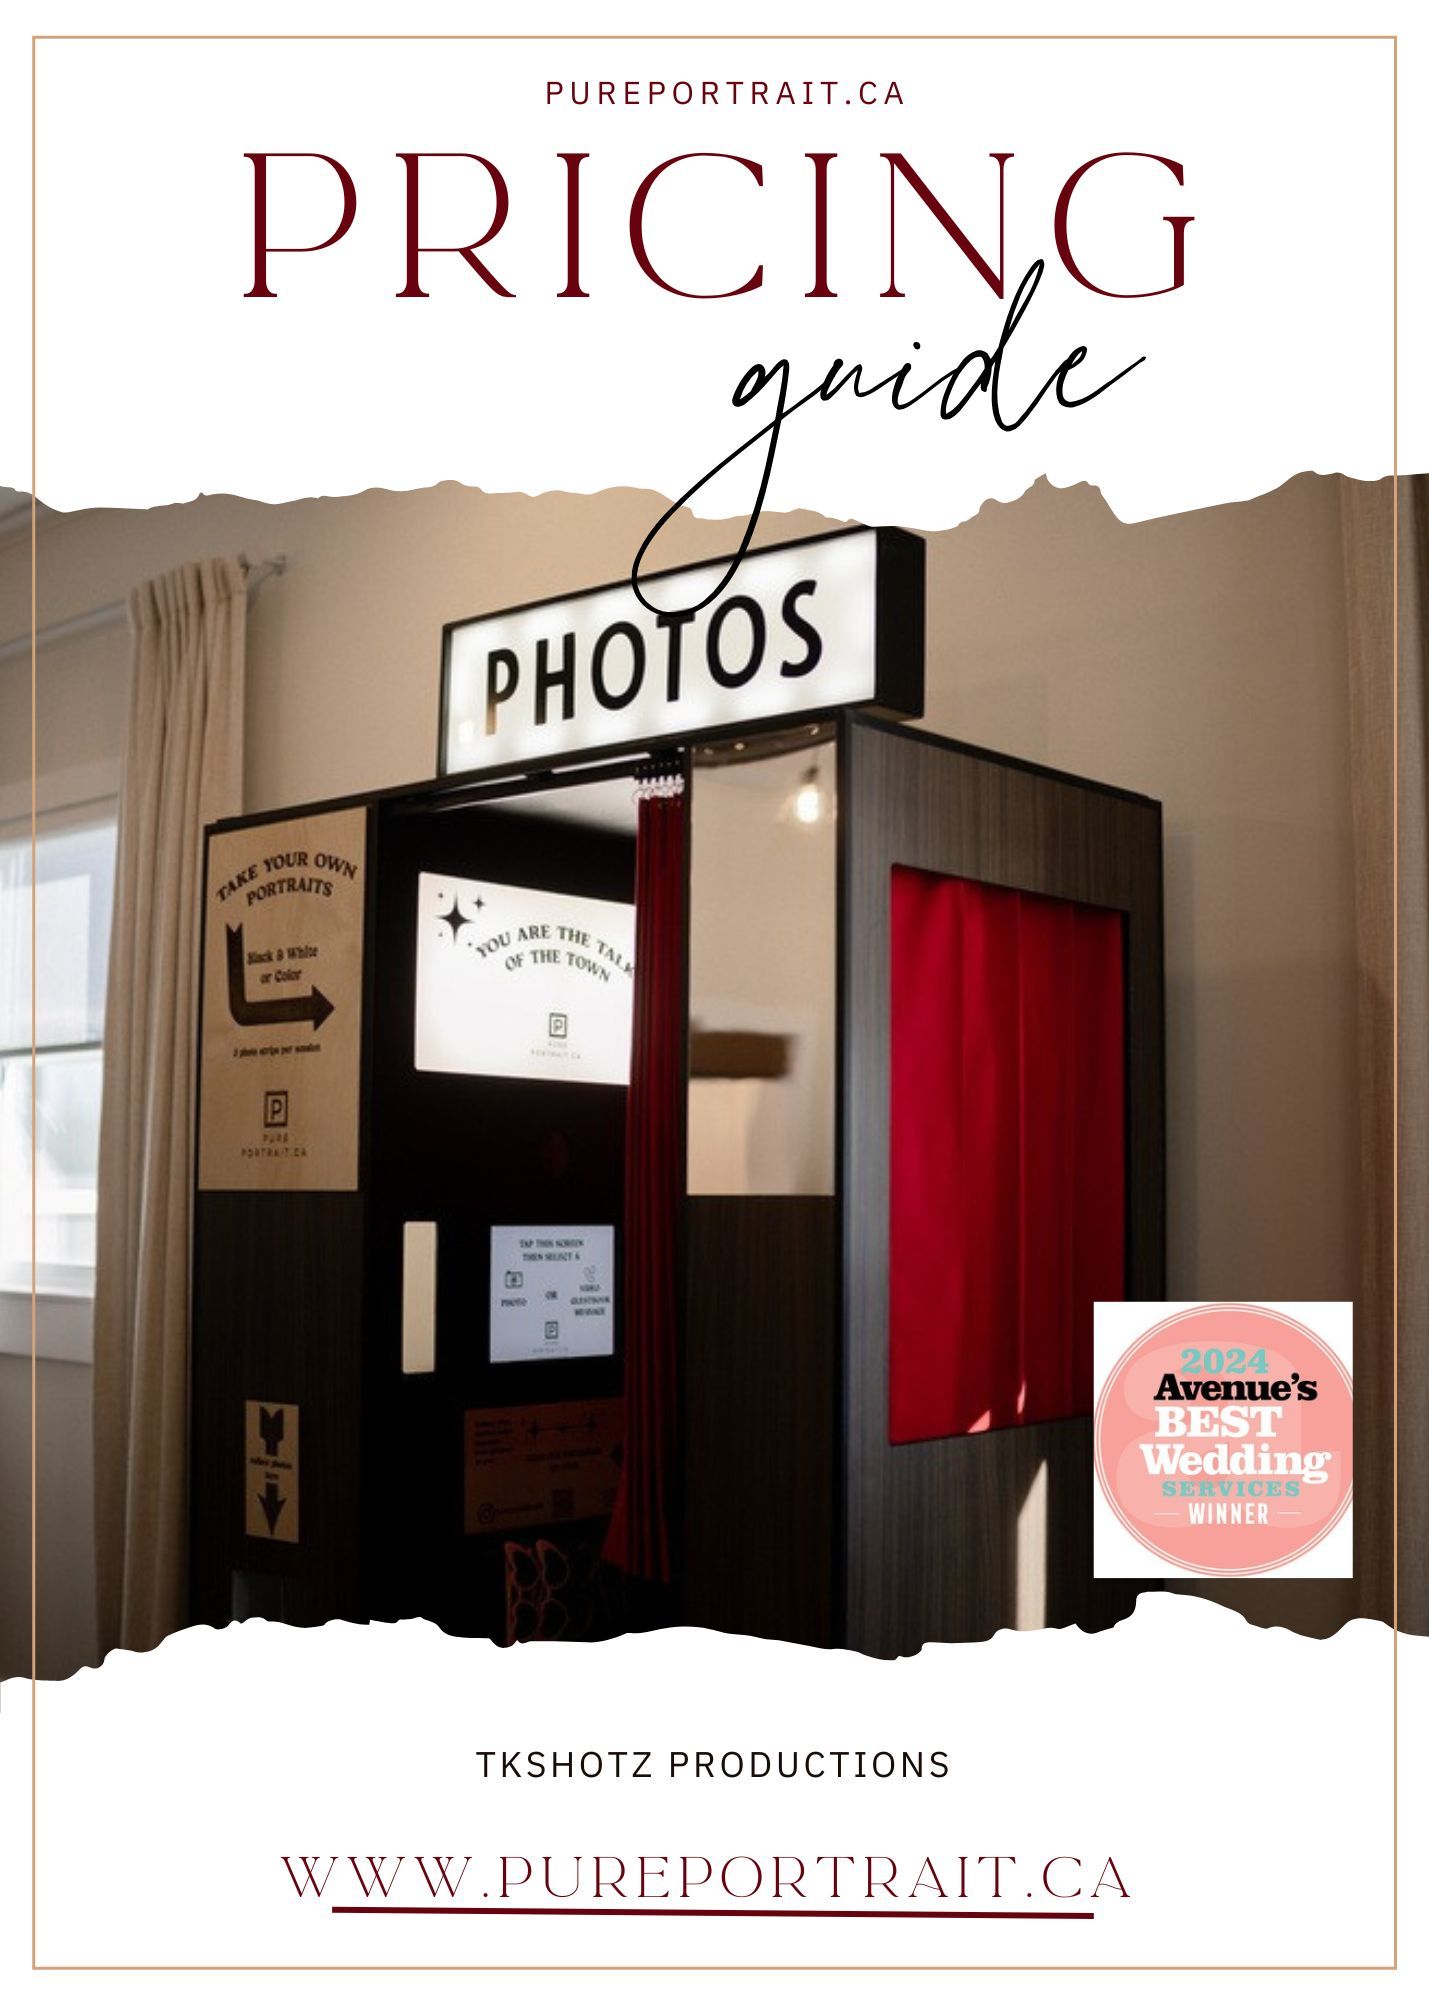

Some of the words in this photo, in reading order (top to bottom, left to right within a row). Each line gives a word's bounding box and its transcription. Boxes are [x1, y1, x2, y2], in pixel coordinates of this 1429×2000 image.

[485, 579, 823, 736] PHOTOS
[215, 864, 259, 902] TAKE
[263, 851, 309, 874] YOUR
[314, 852, 358, 881] OWN
[246, 877, 334, 906] PORTRAITS
[287, 946, 319, 959] White
[475, 931, 511, 959] YOU
[518, 924, 551, 941] ARE
[556, 925, 592, 948] THE
[505, 952, 525, 972] OF
[530, 949, 561, 964] THE
[566, 951, 611, 983] TOWN
[270, 1098, 283, 1121] P
